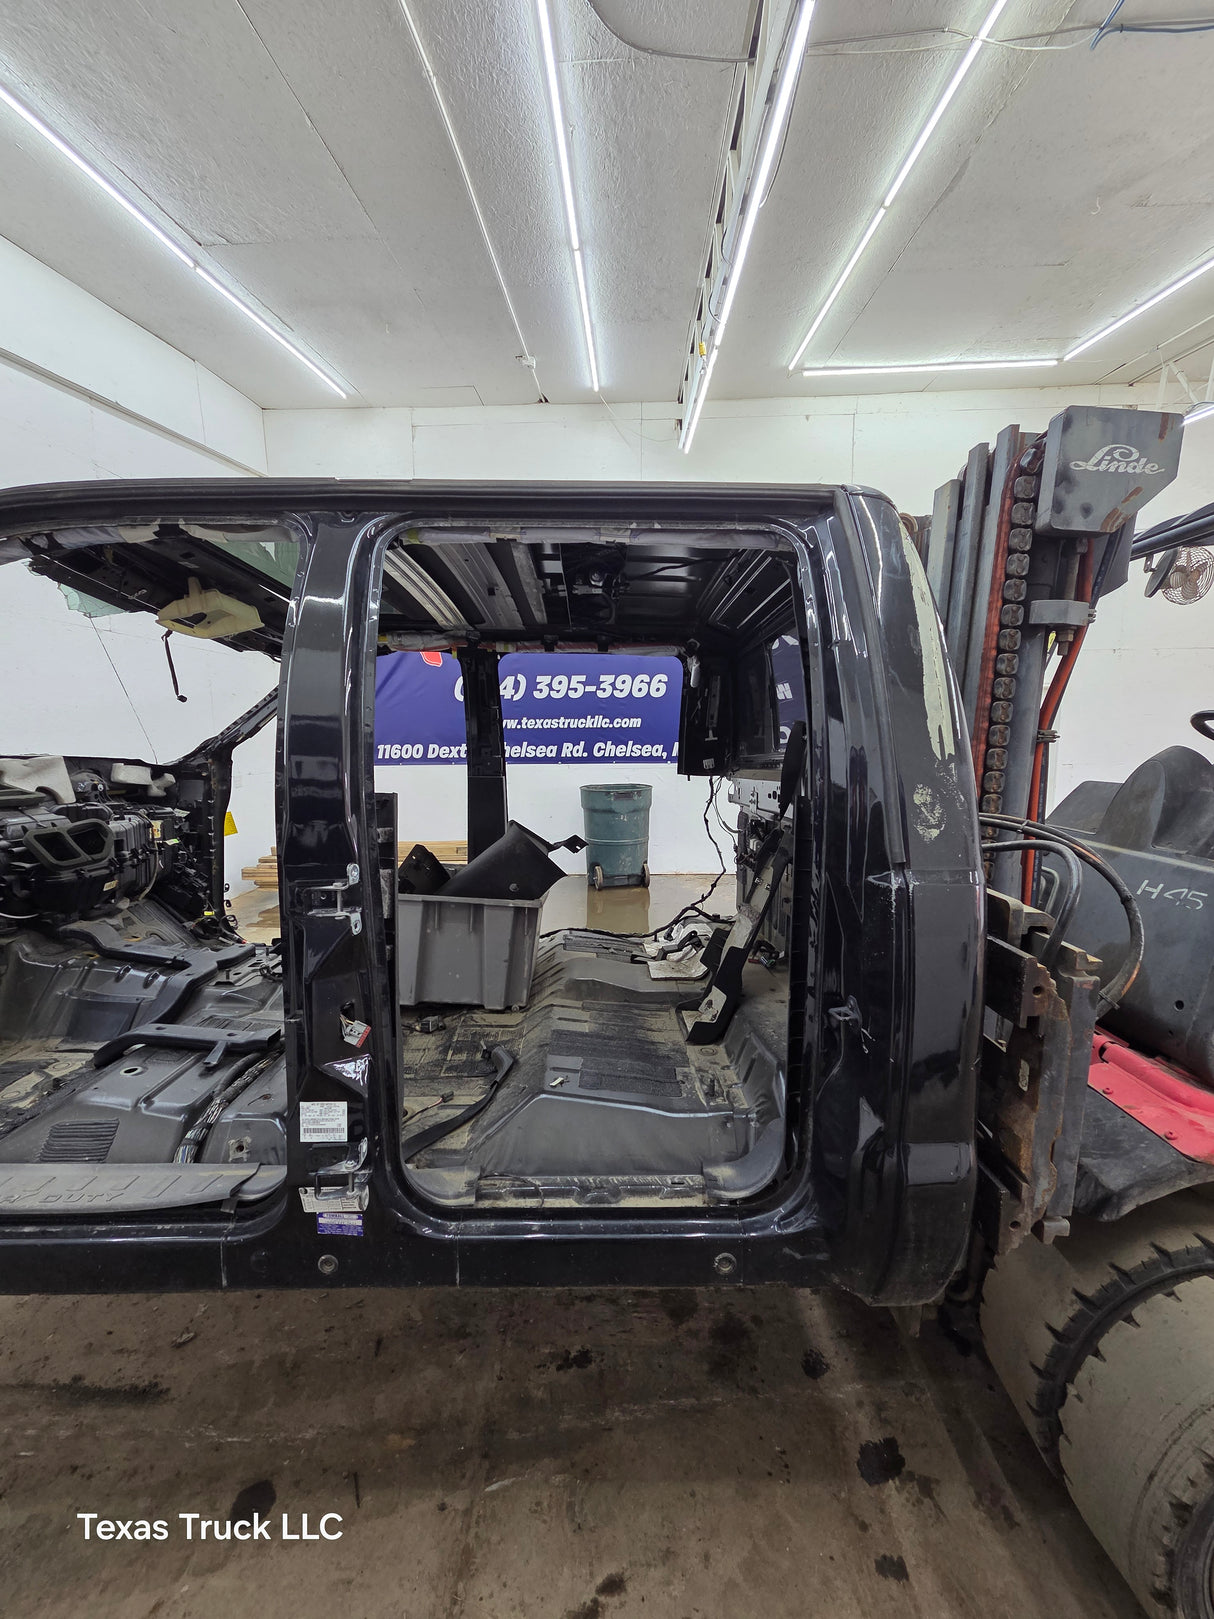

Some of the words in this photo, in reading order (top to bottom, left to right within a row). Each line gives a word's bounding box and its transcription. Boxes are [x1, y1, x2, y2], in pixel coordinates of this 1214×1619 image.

[1069, 444, 1166, 475] Linde
[454, 674, 527, 701] (4)
[533, 674, 668, 699] 395-3966
[502, 715, 642, 729] w.texastruckllc.com
[377, 743, 424, 759] 11600
[427, 743, 467, 759] Dext
[504, 741, 557, 757] helsea
[561, 741, 588, 758] Rd.
[593, 740, 668, 759] Chelsea,
